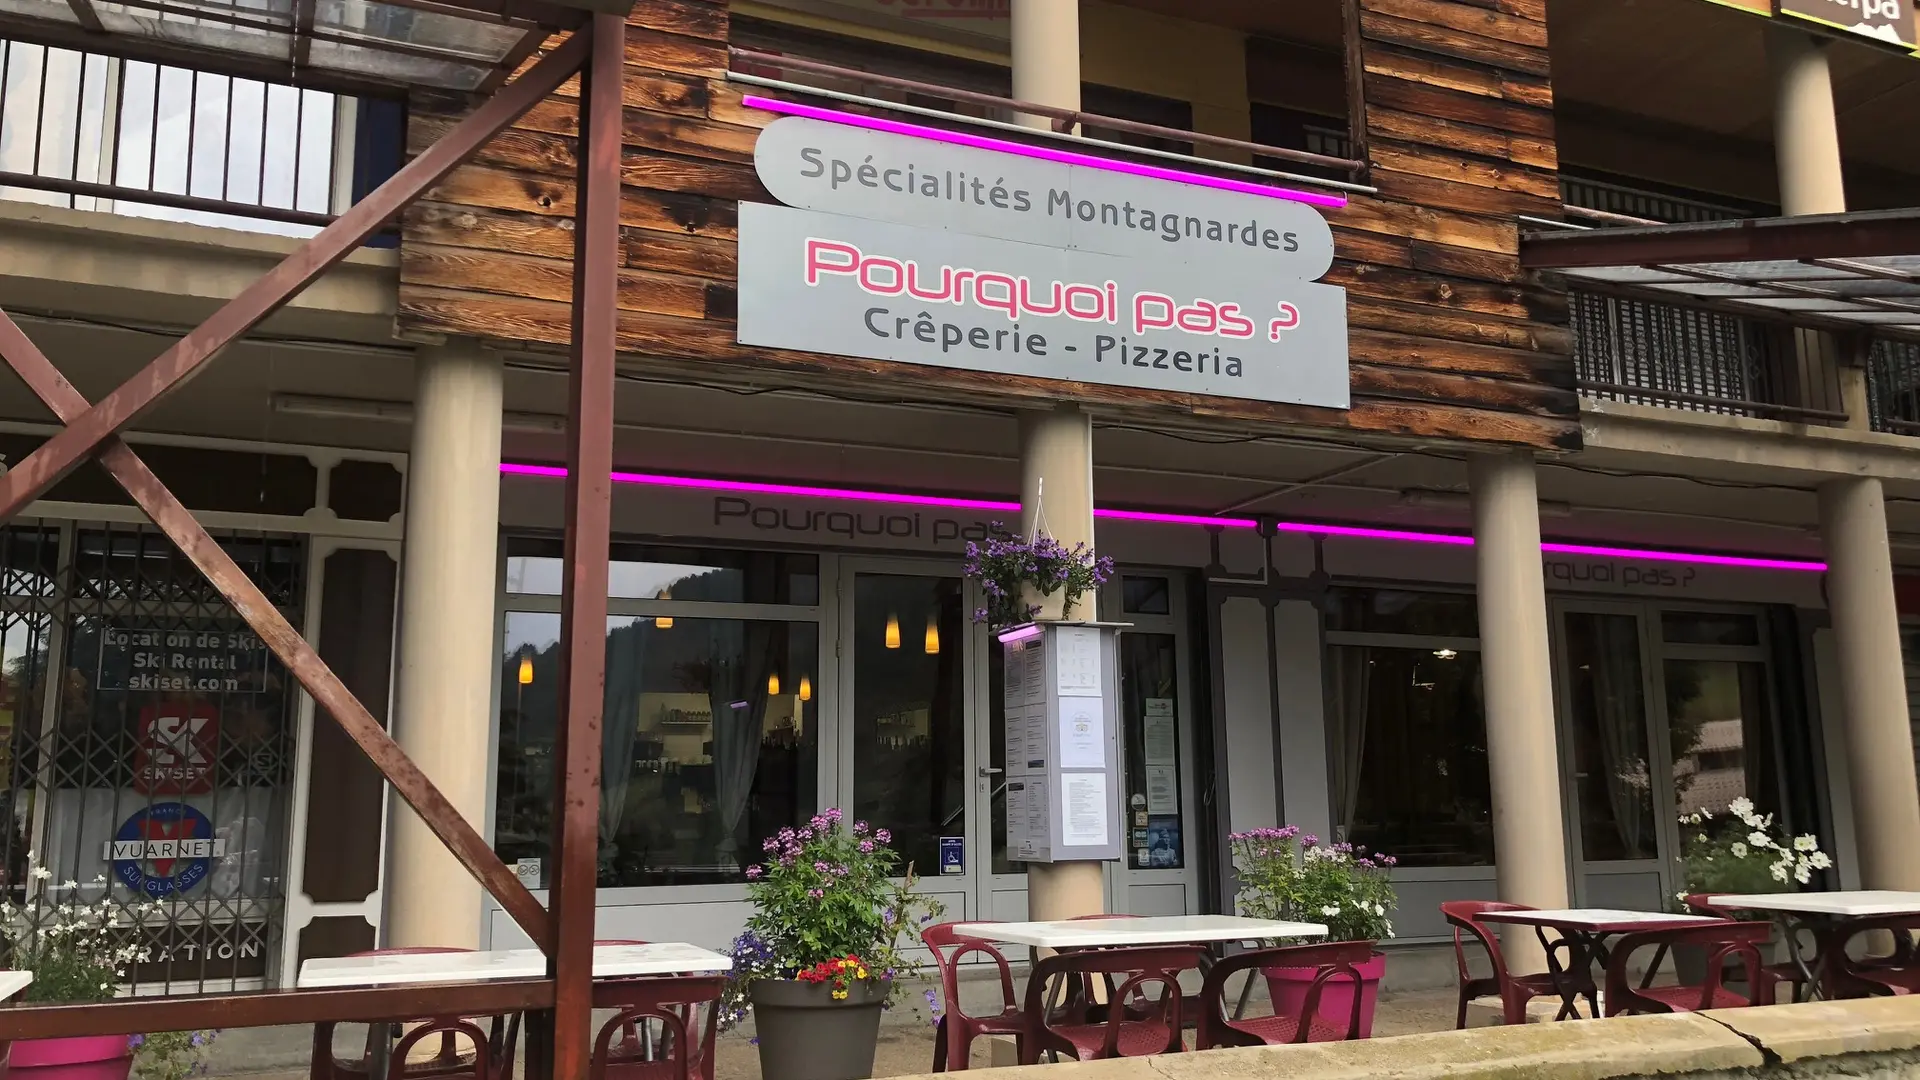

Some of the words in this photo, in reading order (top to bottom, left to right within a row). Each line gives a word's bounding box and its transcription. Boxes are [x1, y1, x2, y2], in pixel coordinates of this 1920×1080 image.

[800, 147, 1031, 210] Spécialités
[1048, 188, 1299, 253] Montagnardes
[803, 238, 1119, 322] Pourquoi
[1133, 291, 1254, 337] pas
[1267, 301, 1301, 344] ?
[864, 308, 1048, 356] Crêperie
[1096, 335, 1243, 379] Pizzeria
[714, 496, 920, 540] Pourquoi
[932, 517, 1013, 545] pas
[1623, 566, 1677, 588] pas
[104, 631, 191, 648] Locaton
[196, 633, 220, 649] de
[133, 652, 166, 668] Ski
[128, 673, 238, 691] skiset.com
[115, 841, 216, 857] VUARNET
